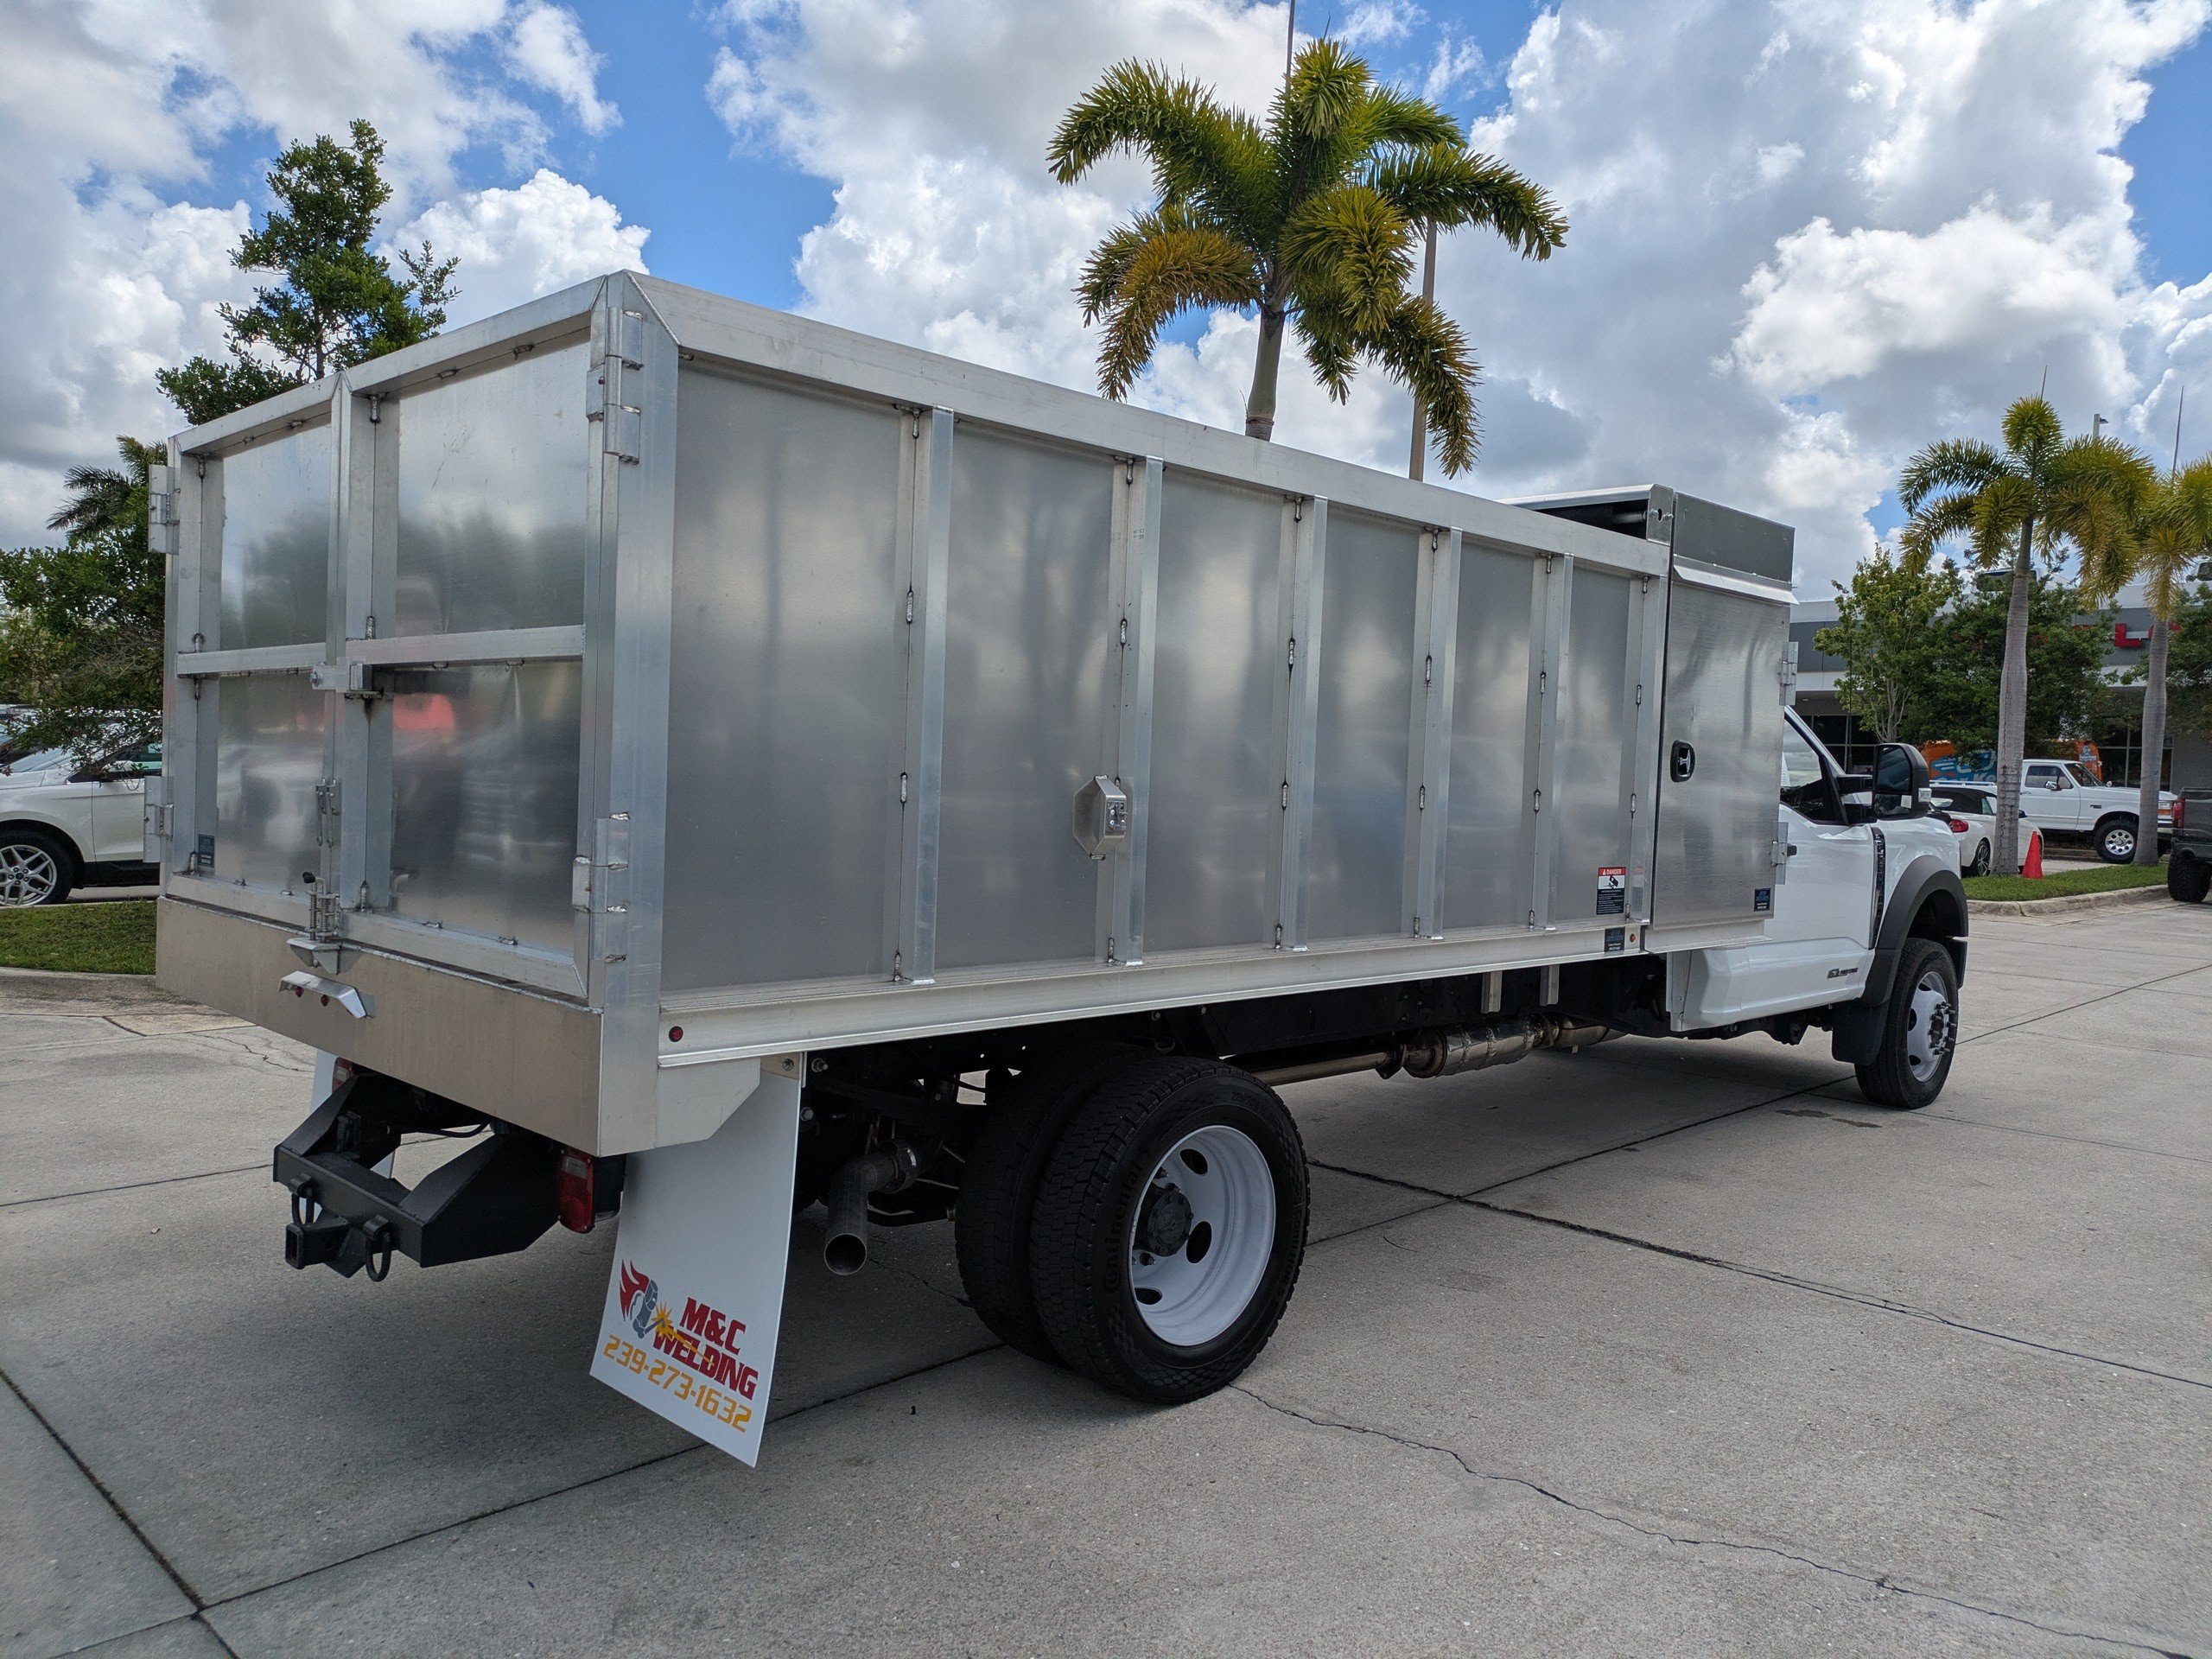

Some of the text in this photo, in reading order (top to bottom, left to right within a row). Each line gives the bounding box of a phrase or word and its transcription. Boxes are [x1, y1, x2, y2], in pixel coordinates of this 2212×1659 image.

[652, 1325, 759, 1401] WELDING
[679, 1297, 747, 1356] M&C
[603, 1334, 753, 1433] 239-273-1632
